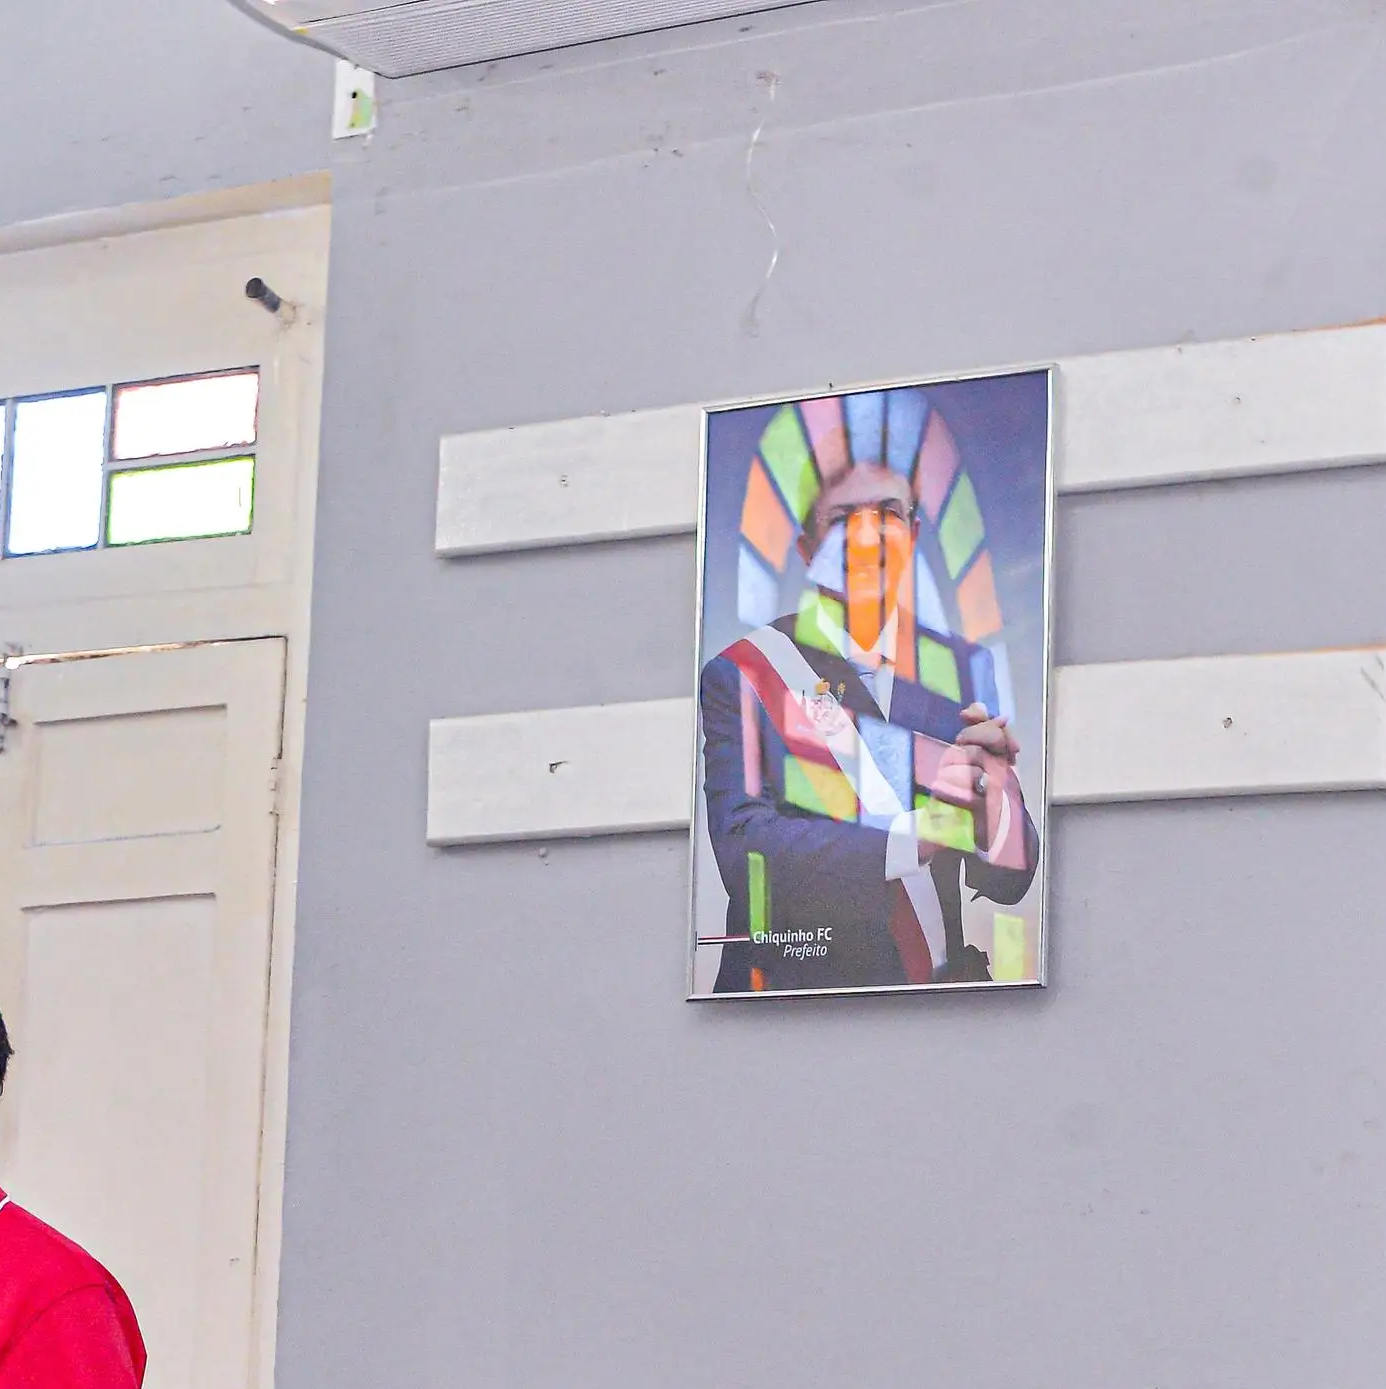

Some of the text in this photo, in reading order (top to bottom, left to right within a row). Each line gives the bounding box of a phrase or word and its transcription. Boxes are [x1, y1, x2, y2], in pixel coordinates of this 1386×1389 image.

[753, 927, 833, 946] Chiquinho FC
[783, 943, 828, 960] Prefeito
